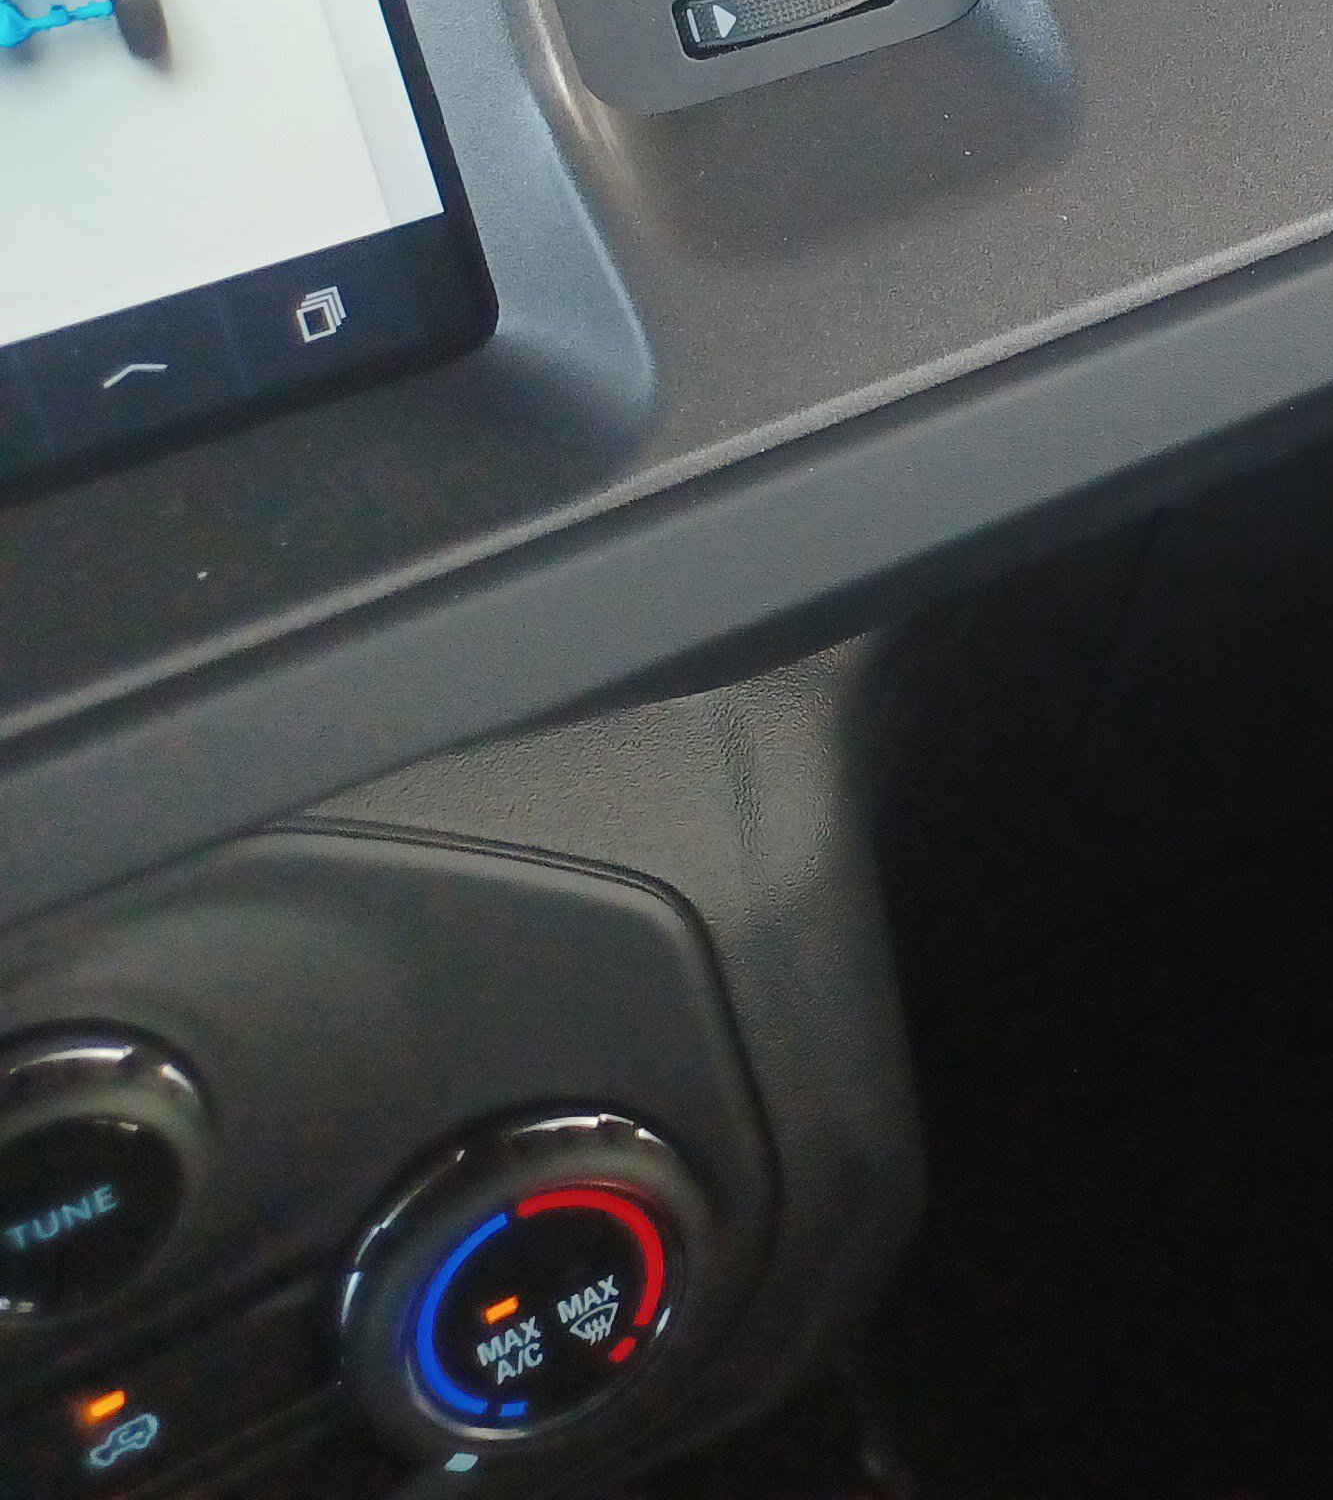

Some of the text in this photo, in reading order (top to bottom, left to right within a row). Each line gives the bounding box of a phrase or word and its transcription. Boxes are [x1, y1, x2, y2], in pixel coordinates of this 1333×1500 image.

[5, 1184, 117, 1250] TUNE
[557, 1274, 619, 1323] MAX
[476, 1315, 542, 1367] MAX
[497, 1342, 543, 1385] A/C
